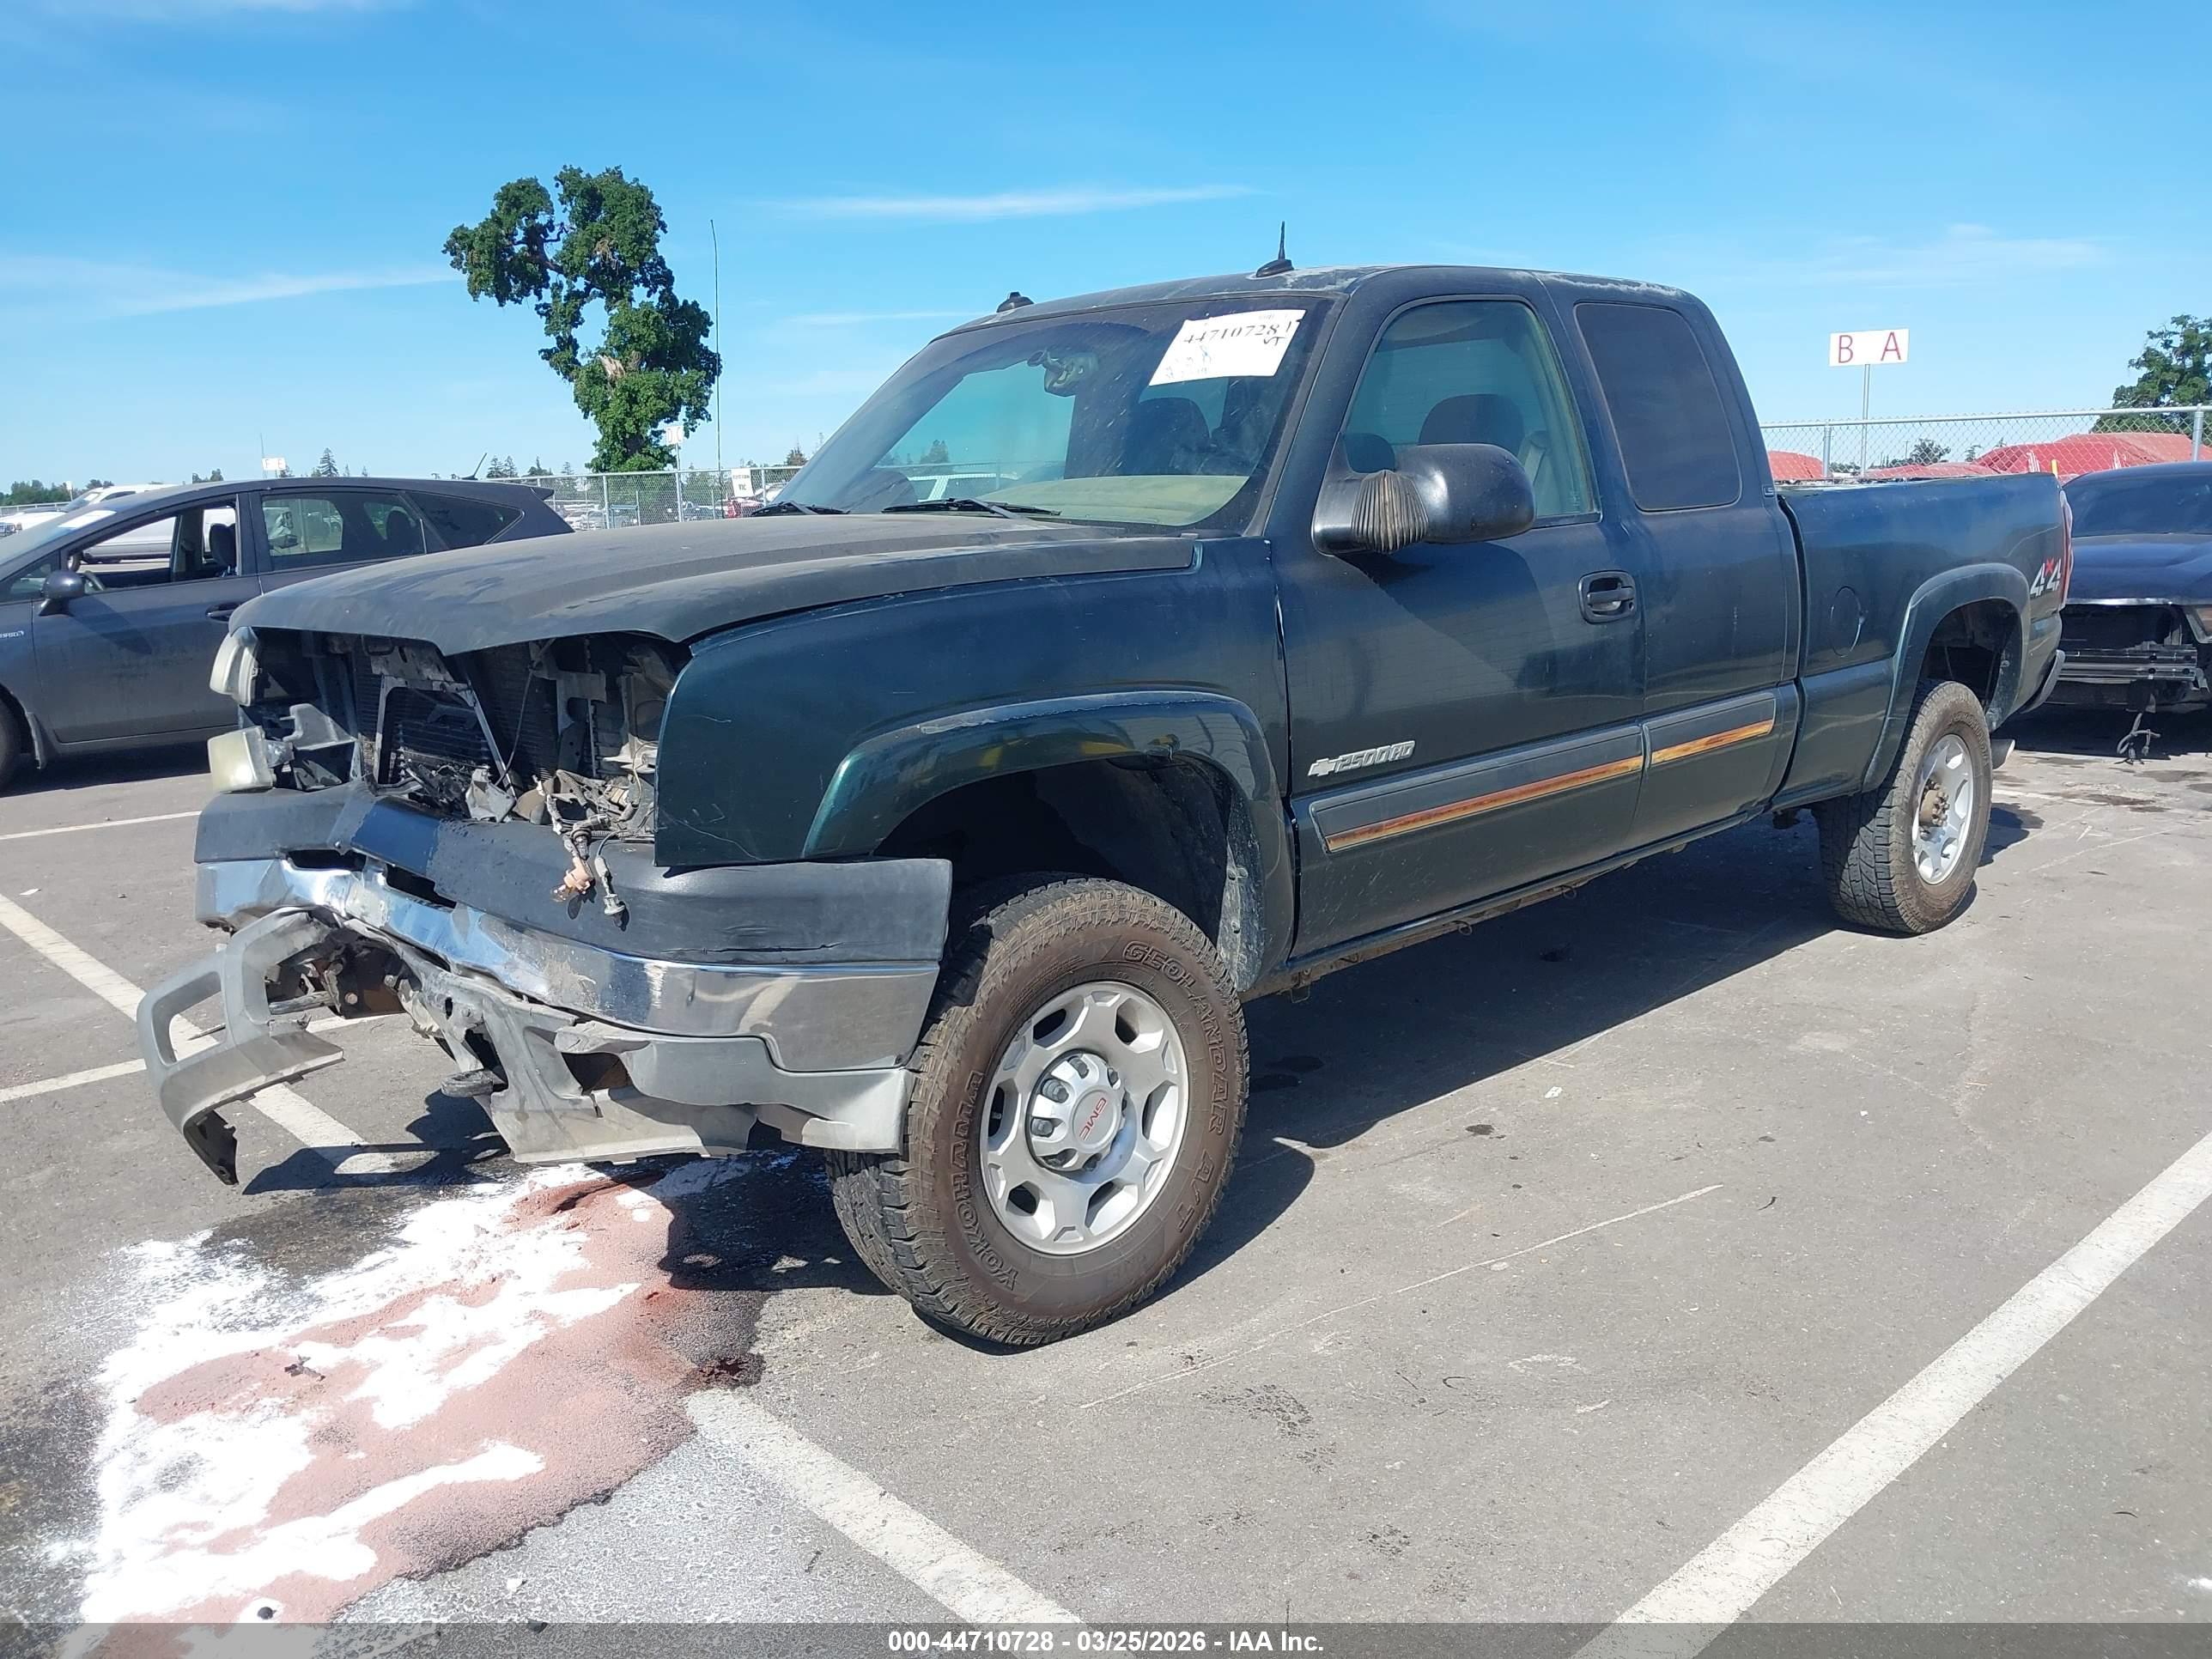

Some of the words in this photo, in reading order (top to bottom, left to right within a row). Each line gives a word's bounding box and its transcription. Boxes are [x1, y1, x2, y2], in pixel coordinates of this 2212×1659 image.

[1838, 334, 1854, 363] B
[1880, 331, 1902, 362] A
[1079, 1097, 1108, 1141] GMC
[951, 1070, 1019, 1291] YOKOHAMA
